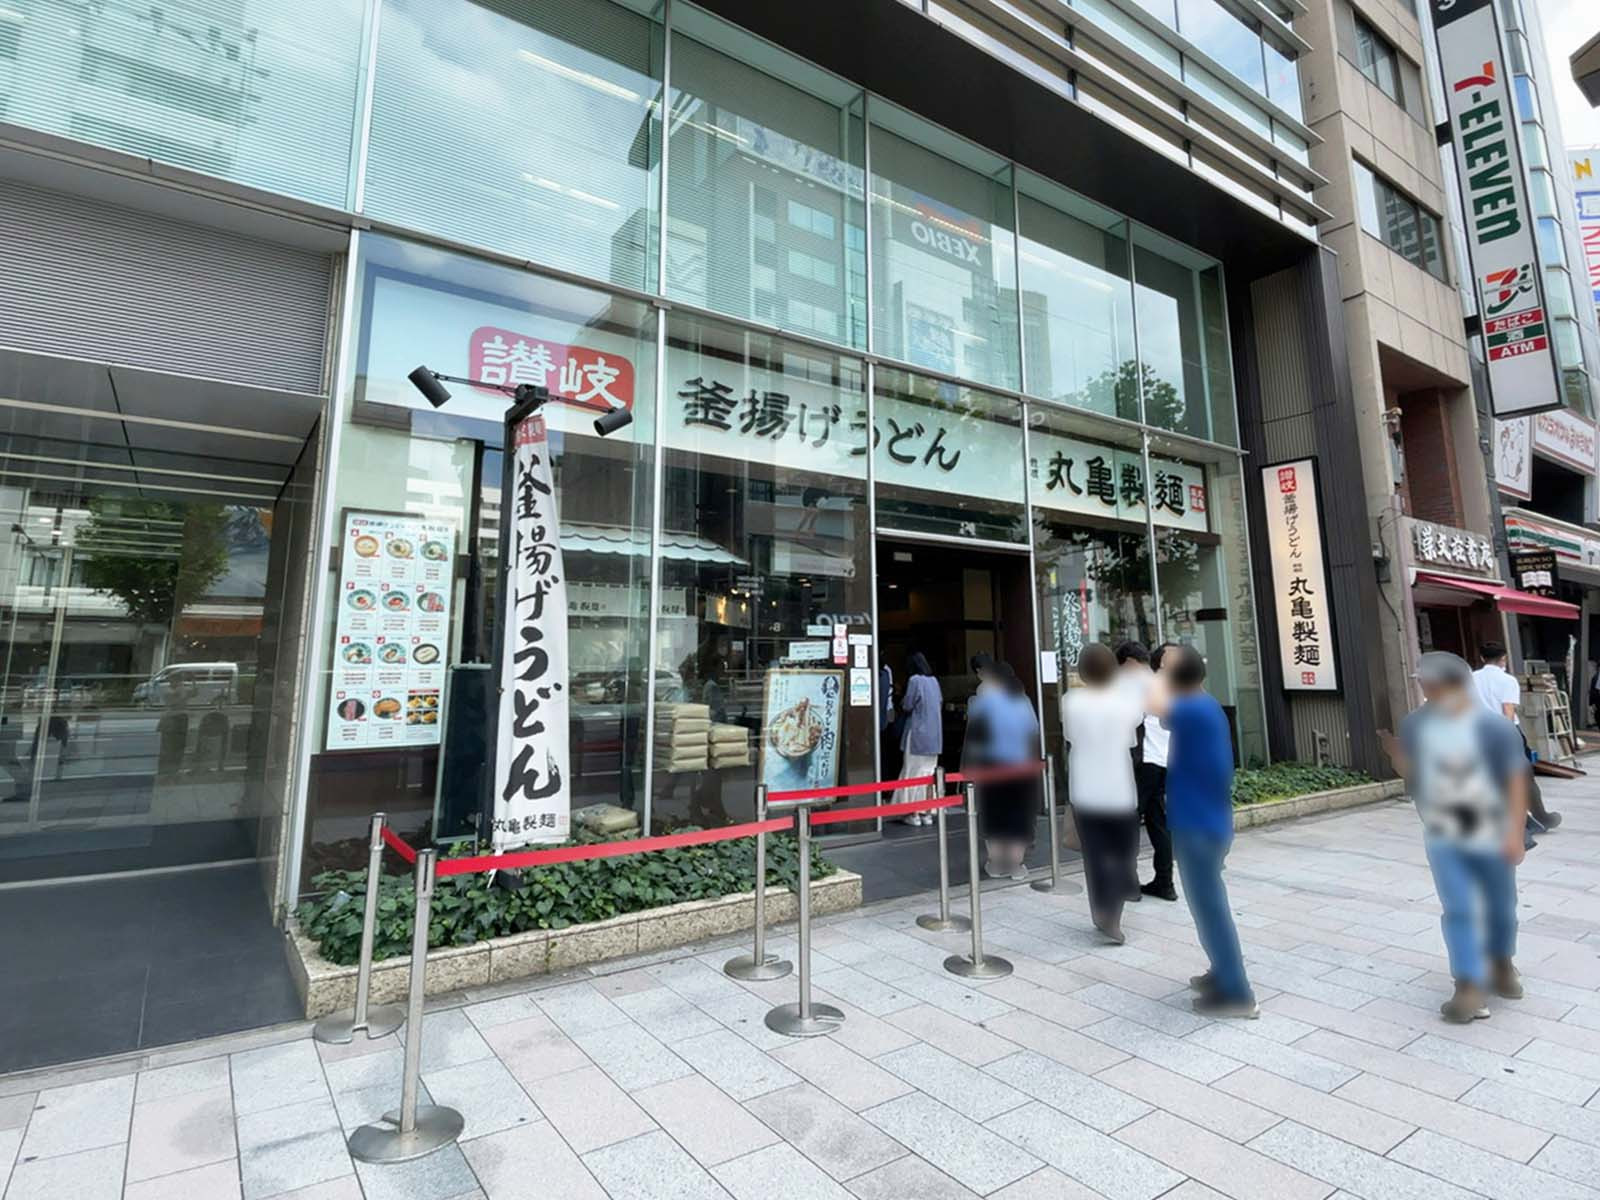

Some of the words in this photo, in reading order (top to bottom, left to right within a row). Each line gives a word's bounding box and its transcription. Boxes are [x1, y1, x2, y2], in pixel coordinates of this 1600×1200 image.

[1494, 313, 1533, 332] たばこ
[1501, 341, 1535, 358] ATM
[480, 335, 626, 409] 讃岐
[677, 376, 961, 472] 釜揚げうどん
[1046, 450, 1186, 517] 丸亀製麺
[1283, 493, 1302, 559] 釜揚げうどん
[1288, 576, 1321, 667] 丸亀製麺
[491, 813, 557, 835] 丸亀製麺
